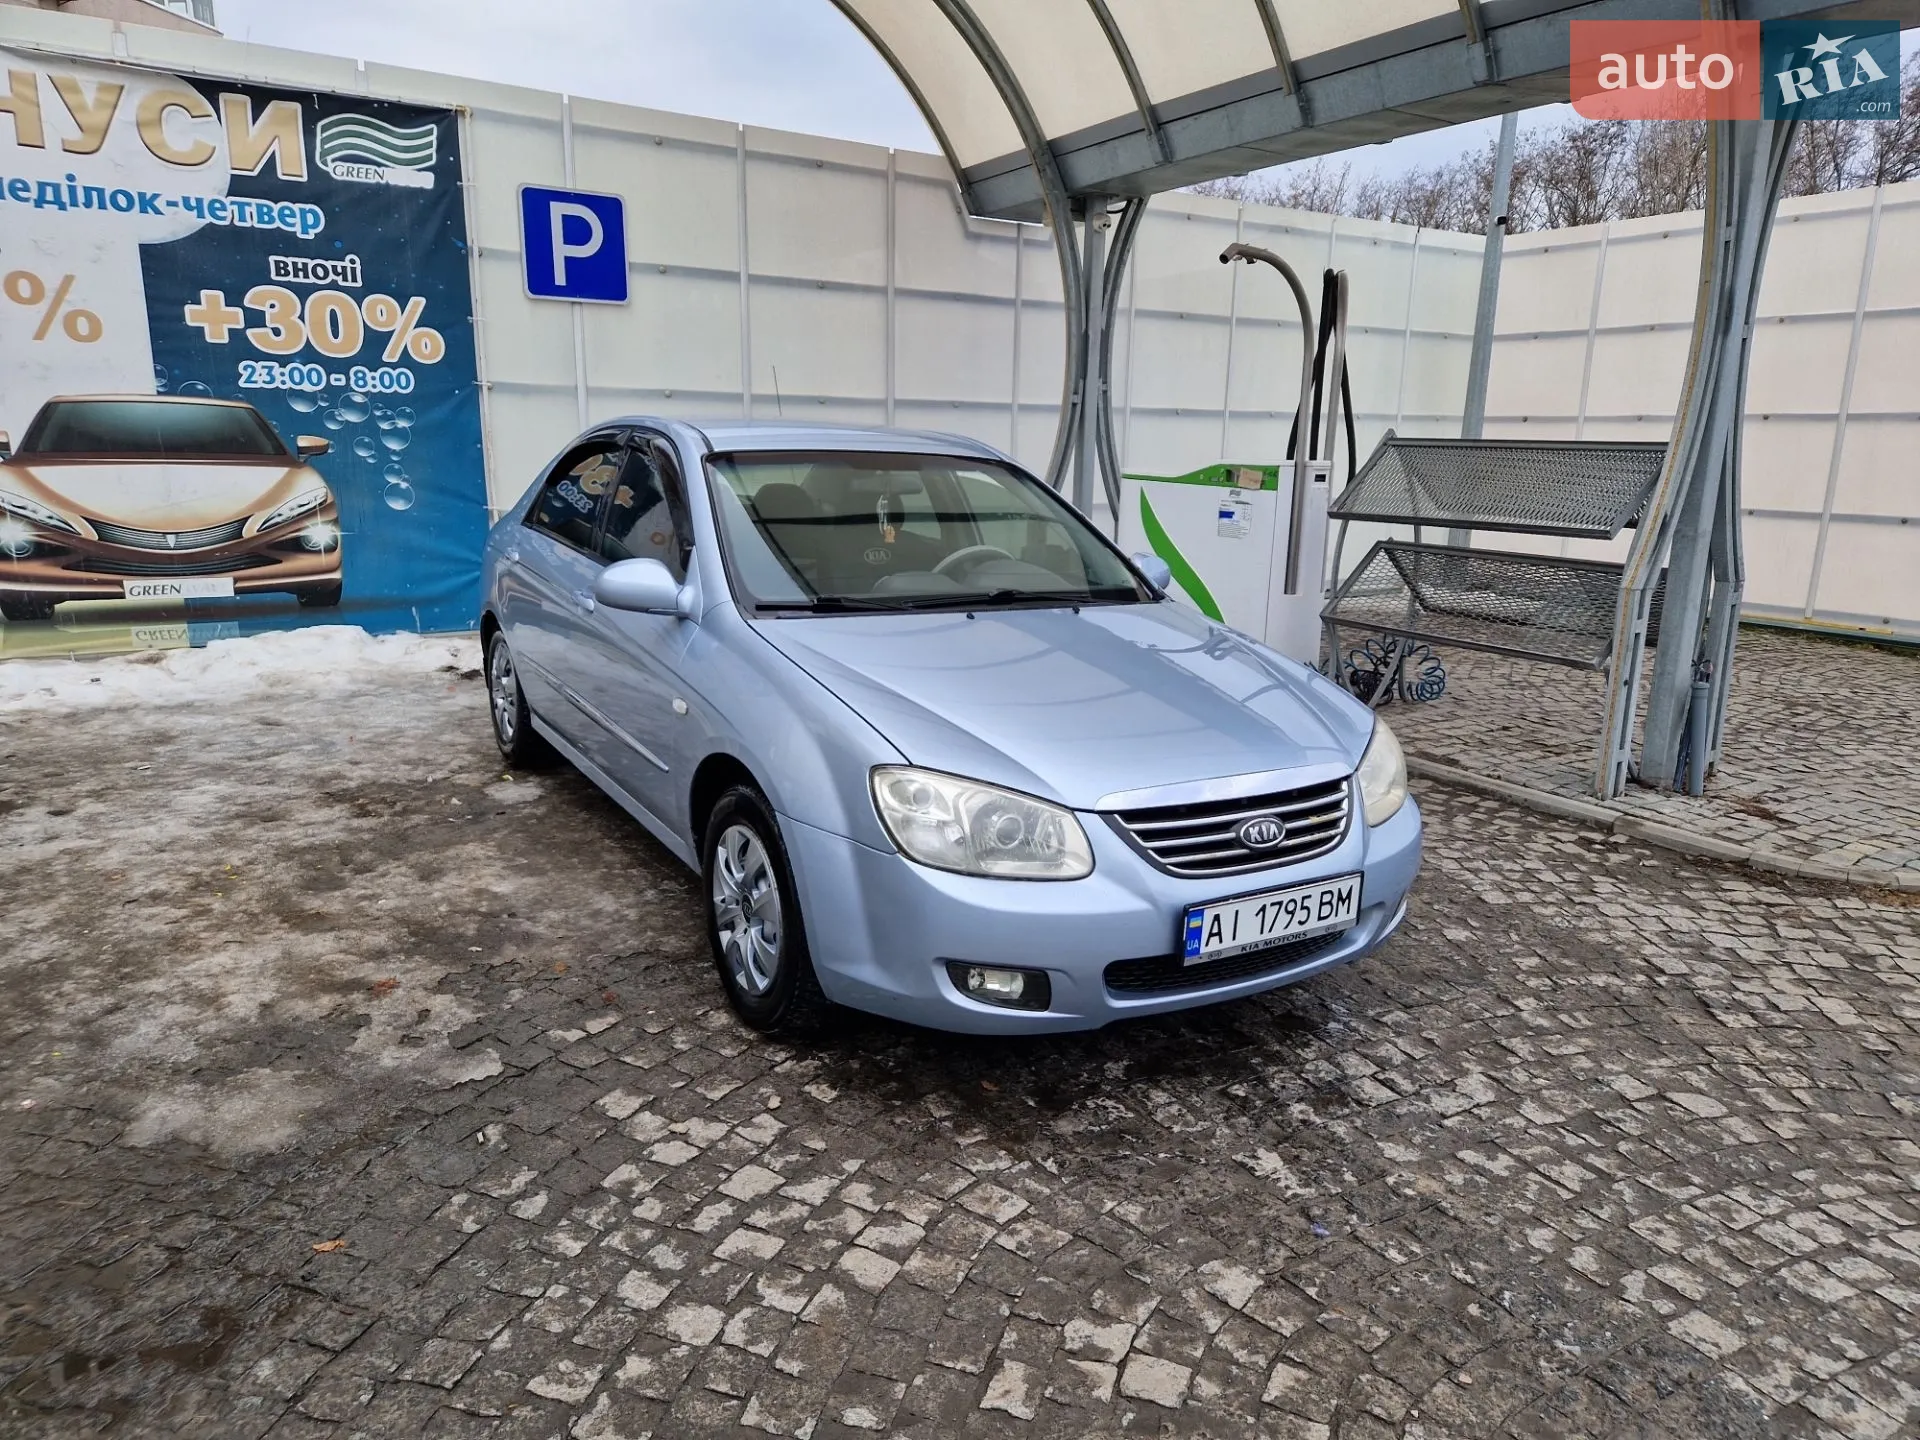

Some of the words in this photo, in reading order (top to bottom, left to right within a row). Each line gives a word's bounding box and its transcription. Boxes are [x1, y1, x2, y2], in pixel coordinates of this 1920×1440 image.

[332, 164, 385, 181] GREEN
[0, 173, 322, 234] еділок-четвер
[550, 201, 604, 286] P
[273, 256, 359, 284] вночі
[186, 286, 444, 362] +30%
[242, 364, 324, 389] 23:00
[352, 368, 412, 391] 8:00
[129, 584, 182, 597] GREEN
[1249, 822, 1280, 843] KIA
[1205, 909, 1239, 947] AI
[1255, 894, 1312, 935] 1795
[1317, 884, 1353, 922] BM
[1187, 939, 1200, 951] UA
[1240, 943, 1260, 953] KIA
[1263, 932, 1308, 947] MOTORS
